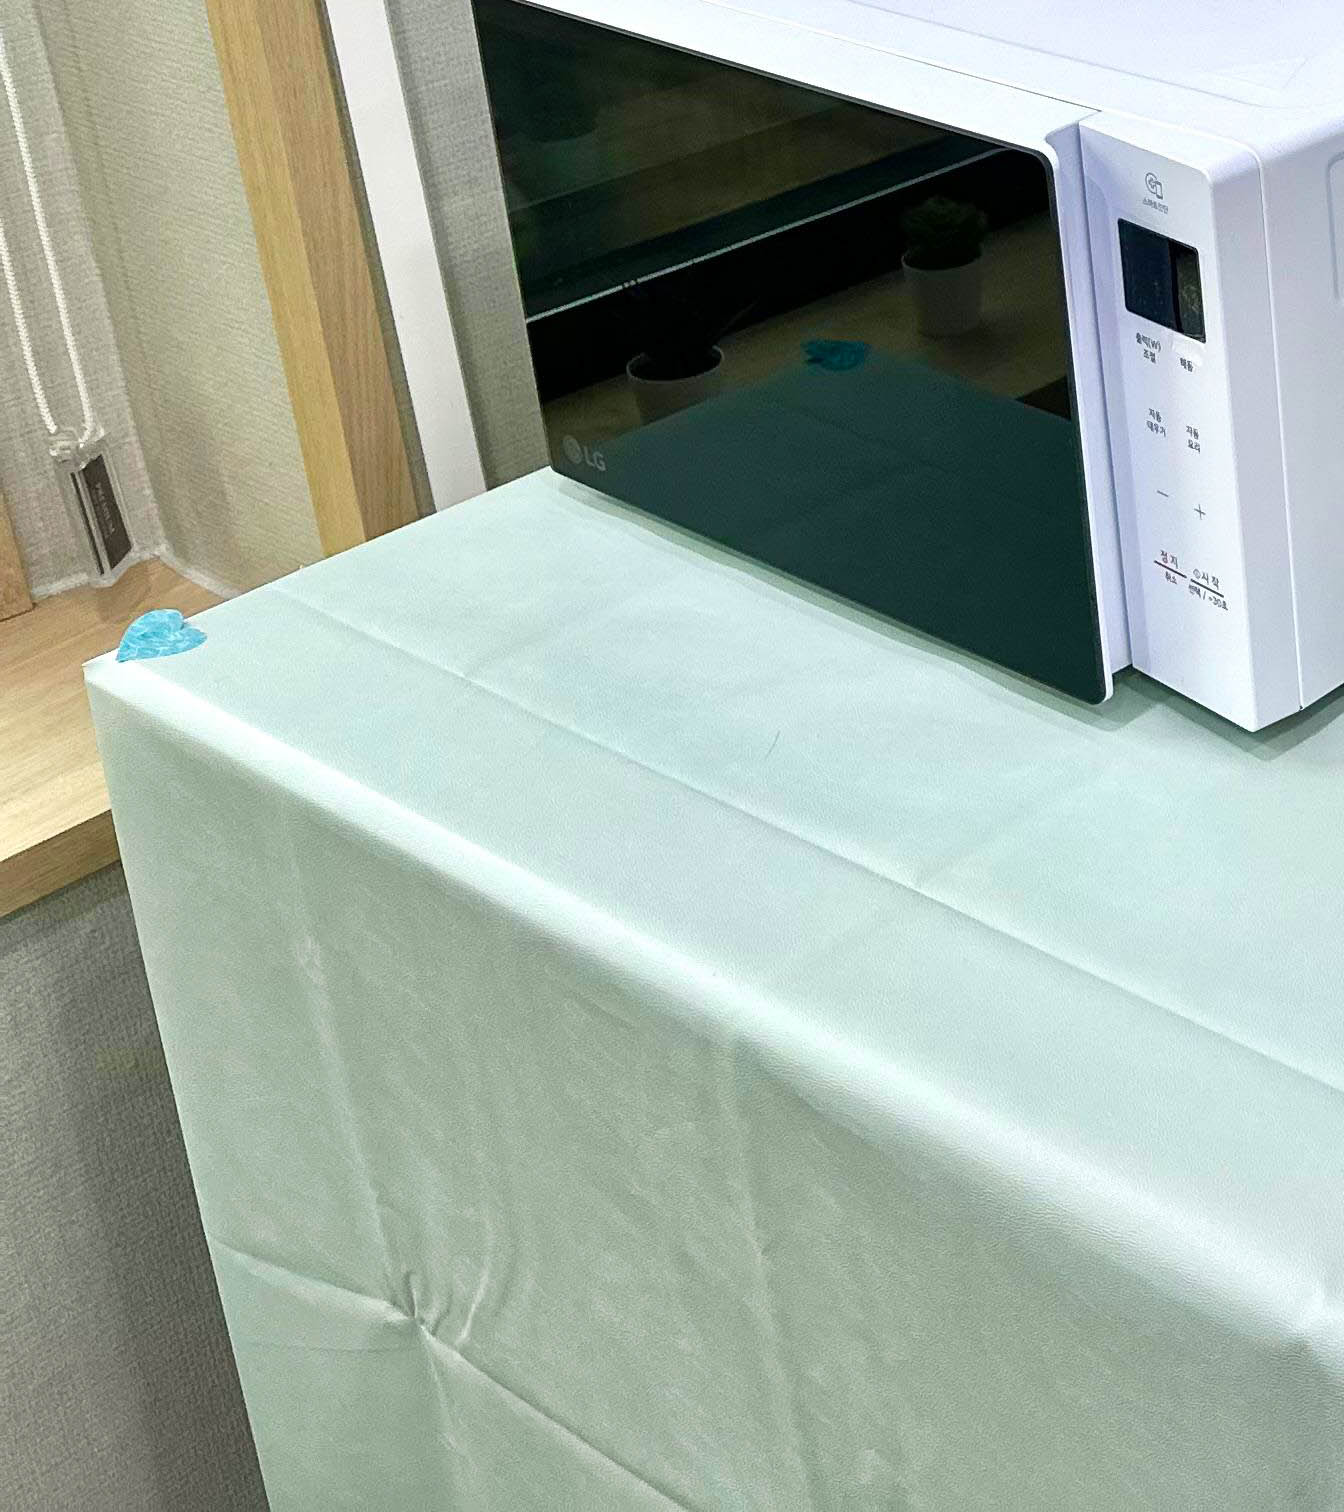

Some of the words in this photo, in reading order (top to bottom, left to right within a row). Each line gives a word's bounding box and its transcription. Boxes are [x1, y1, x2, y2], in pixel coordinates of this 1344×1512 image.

[1149, 407, 1162, 423] 자동
[1186, 425, 1199, 440] 자동
[584, 446, 606, 472] LG
[1160, 549, 1179, 569] 정지
[1201, 572, 1220, 590] 시작
